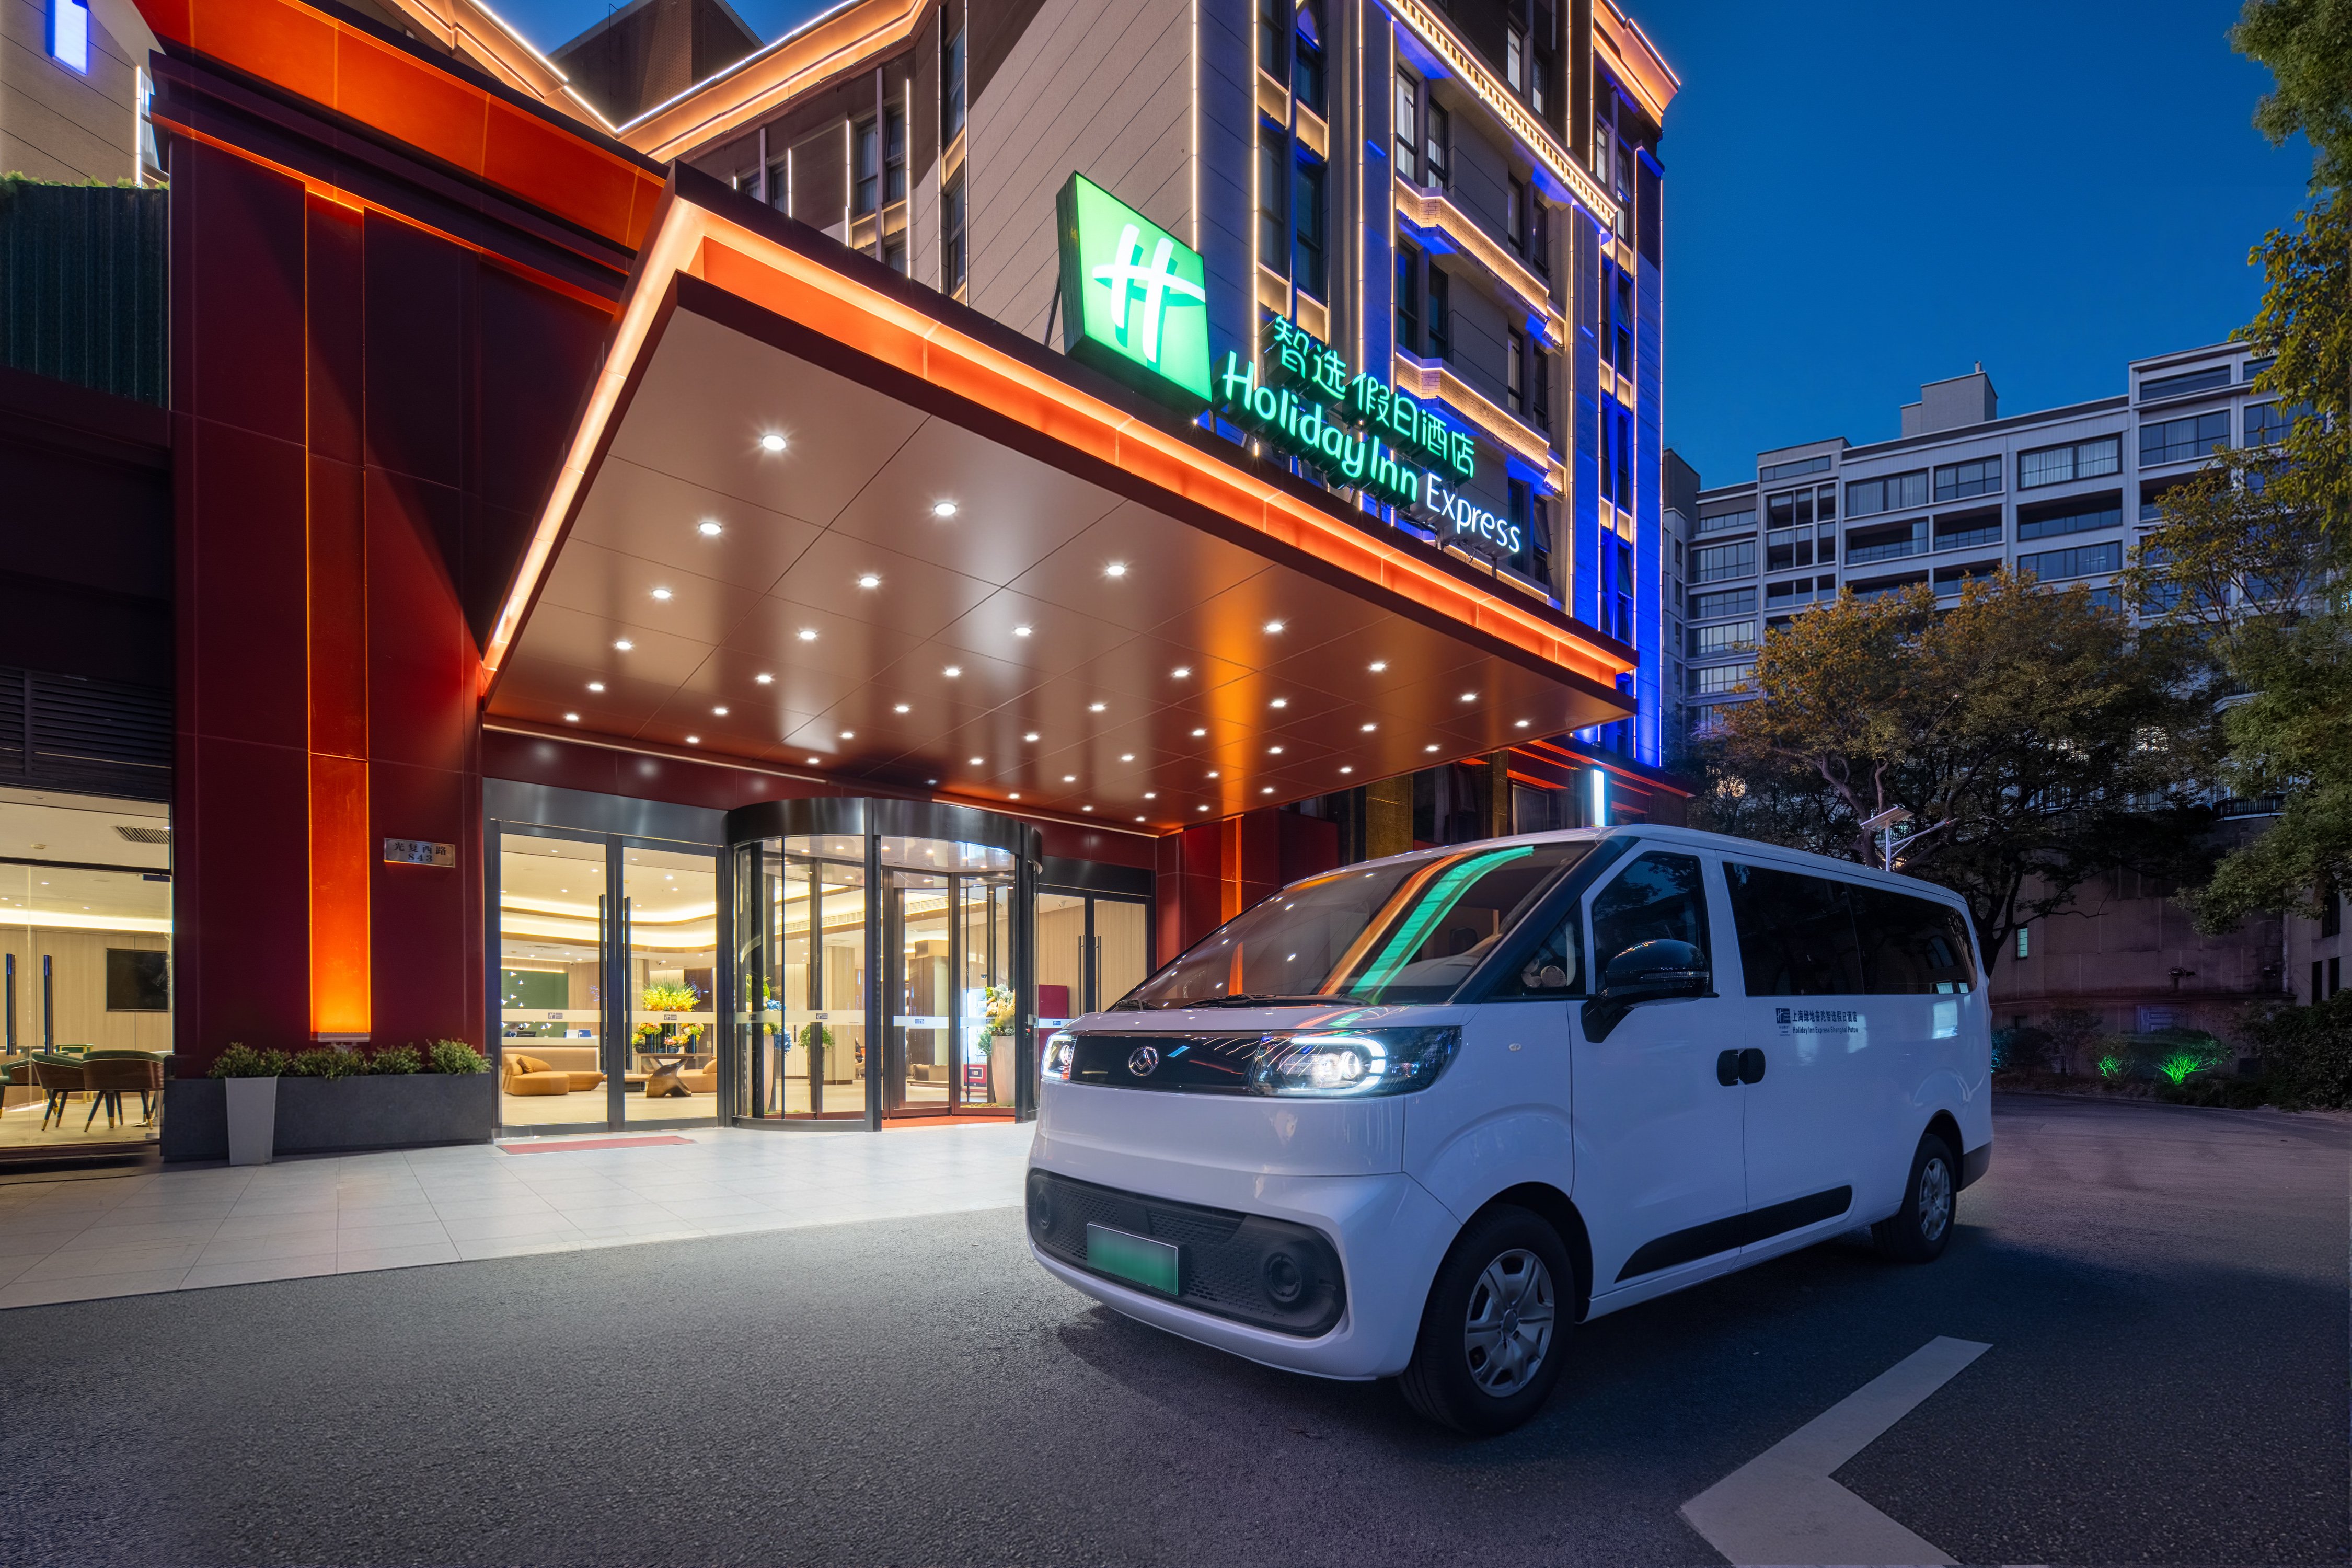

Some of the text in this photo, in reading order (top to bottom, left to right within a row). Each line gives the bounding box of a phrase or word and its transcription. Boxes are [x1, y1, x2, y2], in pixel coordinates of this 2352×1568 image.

[1274, 315, 1474, 478] 智选假日酒店
[1222, 350, 1520, 552] Holiday Inn Express
[394, 842, 446, 855] 光复西路
[408, 853, 432, 862] 843
[1792, 1010, 1857, 1022] 上海绿地普陀智选假日酒店
[1793, 1026, 1807, 1035] Holiday
[1815, 1026, 1830, 1034] Express
